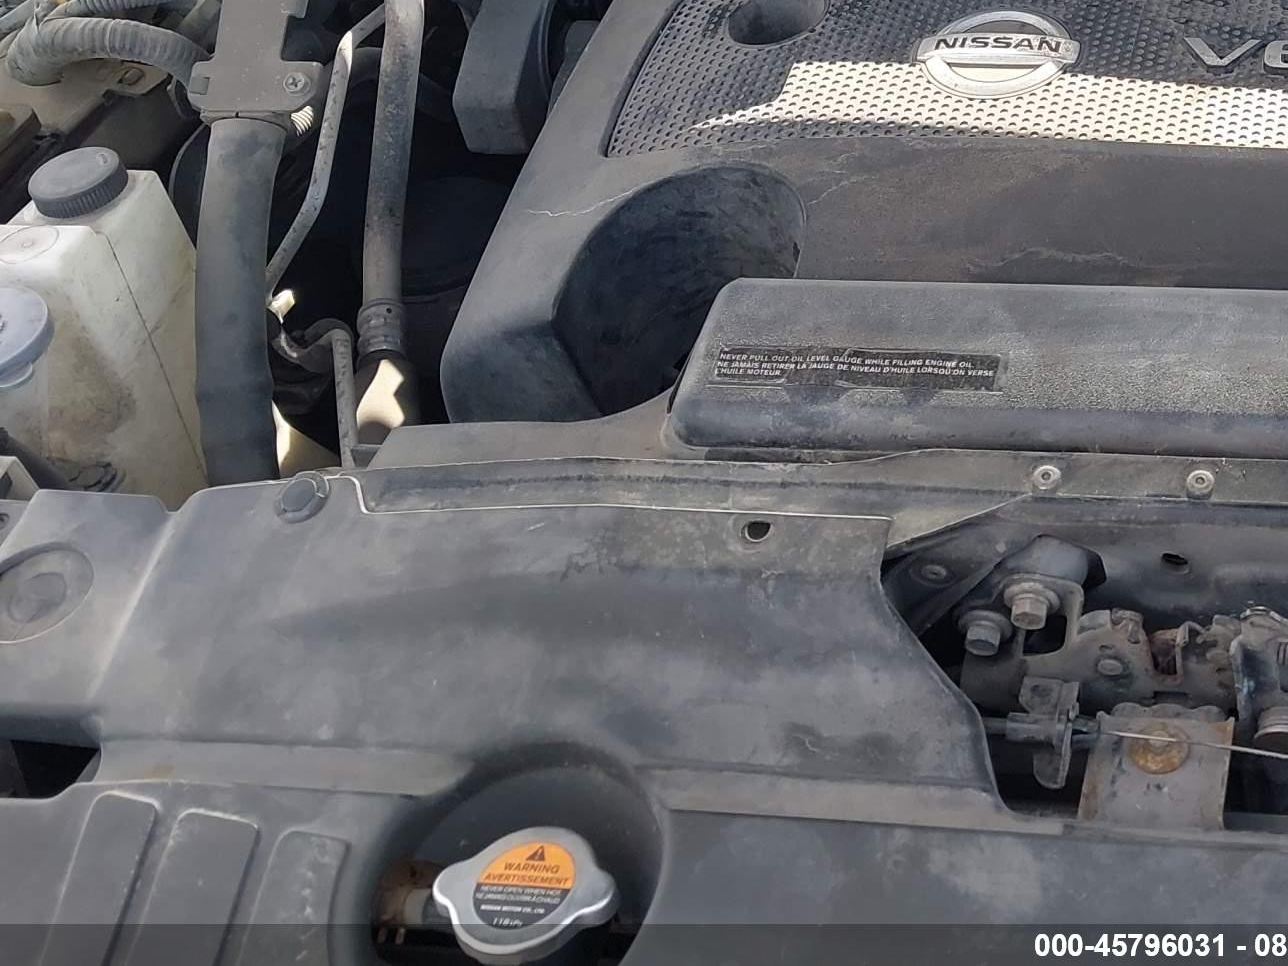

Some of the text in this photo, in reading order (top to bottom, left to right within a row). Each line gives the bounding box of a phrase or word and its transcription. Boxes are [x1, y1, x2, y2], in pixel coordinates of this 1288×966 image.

[934, 36, 1062, 53] NISSAN
[719, 353, 747, 361] NEVER
[749, 354, 769, 362] PULL
[771, 354, 788, 362] OUT
[832, 355, 862, 365] GAUGE
[925, 359, 957, 368] ENGINE
[731, 361, 760, 369] JAMAIS
[883, 366, 915, 374] D'HUILE
[504, 862, 560, 874] WARNING
[484, 873, 570, 886] AVERTISSEMENT
